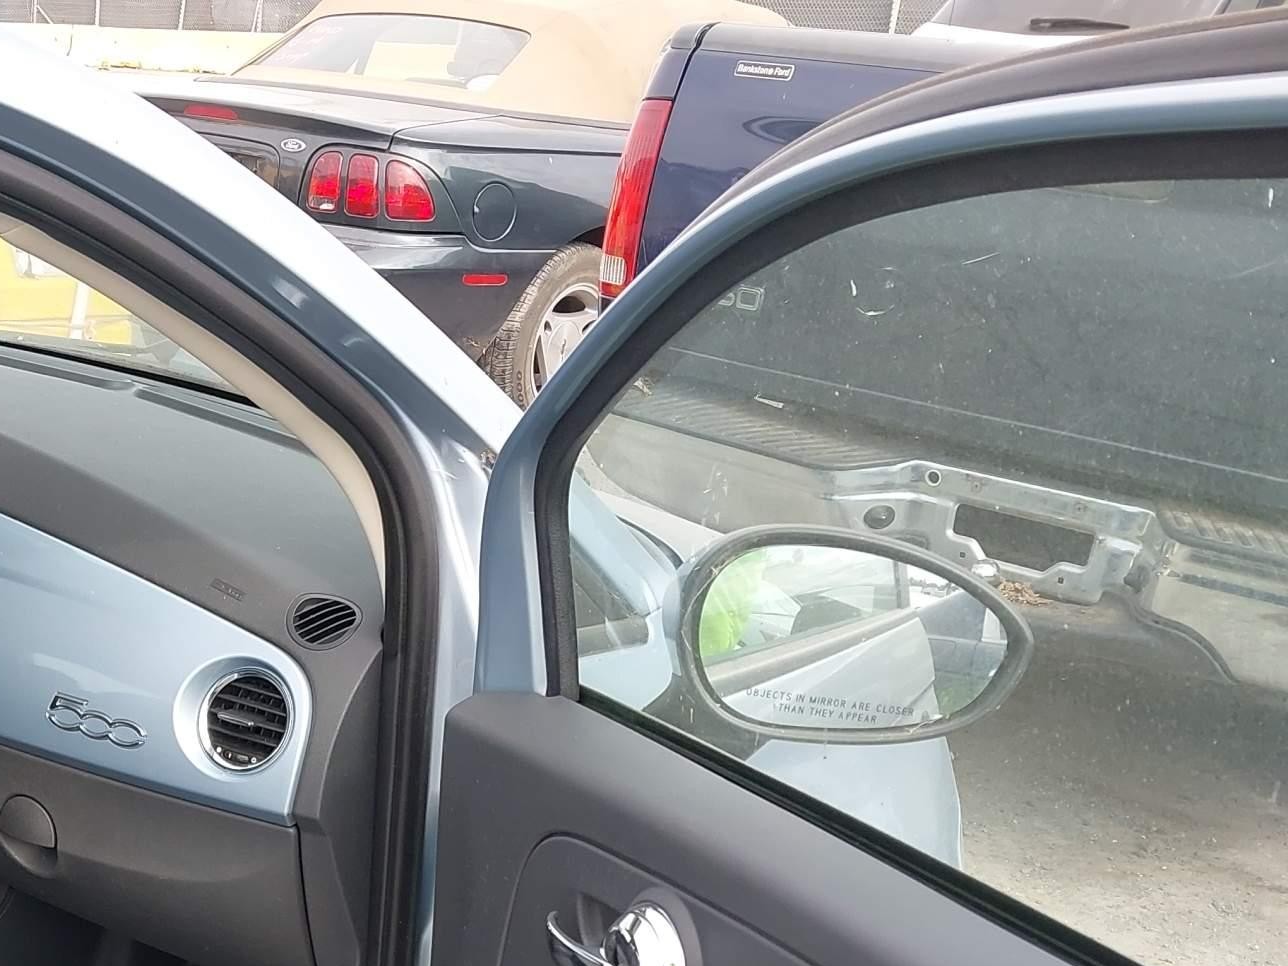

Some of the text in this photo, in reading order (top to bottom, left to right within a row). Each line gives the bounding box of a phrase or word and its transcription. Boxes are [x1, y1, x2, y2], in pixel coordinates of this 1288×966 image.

[774, 67, 791, 76] Ford
[746, 688, 915, 717] OBJECTS IN MIRROR ARE CLOSER
[778, 702, 878, 724] THAN THEY APPEAR
[46, 691, 146, 750] 500
